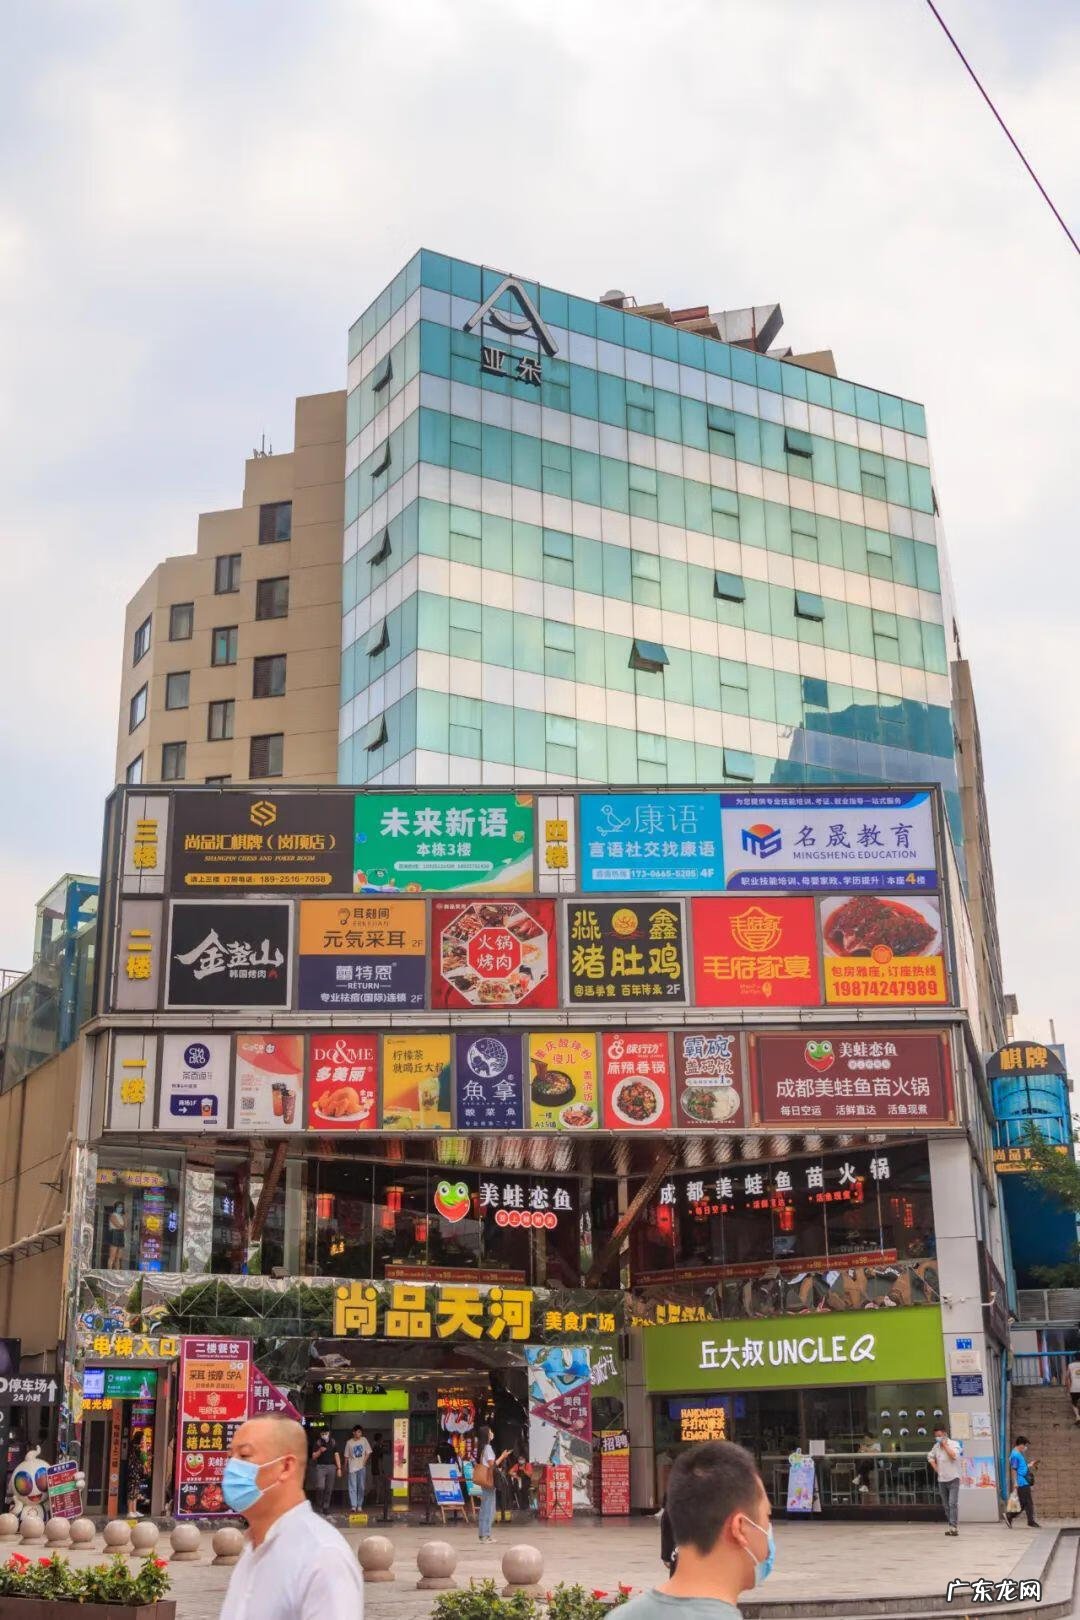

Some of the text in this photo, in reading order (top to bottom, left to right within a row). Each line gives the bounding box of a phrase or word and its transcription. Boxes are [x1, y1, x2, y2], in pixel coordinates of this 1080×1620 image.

[481, 346, 542, 384] 亚朵
[380, 807, 508, 838] 未来新语
[634, 804, 698, 835] 康语
[134, 819, 158, 869] 三楼
[545, 819, 569, 869] 四楼
[794, 823, 914, 849] 名晟教育
[416, 842, 472, 857] 本栋3楼
[588, 840, 715, 858] 言语社交找康语
[793, 850, 917, 859] MINGSHENG EDUCATION
[700, 868, 714, 878] 4F
[412, 940, 423, 948] 2F
[478, 935, 514, 951] 火锅
[126, 929, 152, 980] 二楼
[476, 954, 512, 971] 烤肉
[571, 944, 681, 980] 猪肚鸡
[229, 968, 267, 979] 韩国烤肉
[703, 956, 811, 980] 毛府家宴
[410, 994, 423, 1003] 2F
[621, 984, 663, 996] 百年传承
[666, 984, 681, 995] 2F
[393, 1049, 424, 1060] 柠檬茶
[840, 1042, 898, 1058] 美蛙恋鱼
[1000, 1046, 1048, 1070] 棋牌
[393, 1062, 444, 1073] 就喝丘大叔
[607, 1061, 666, 1075] 麻辣香锅
[120, 1059, 147, 1105] 一楼
[462, 1079, 517, 1101] 魚拿
[776, 1077, 931, 1098] 成都美蛙鱼苗火锅
[780, 1104, 928, 1116] 每日空运 活鲜直达 活鱼现煮
[659, 1157, 891, 1205] 成都美蛙鱼苗火锅
[479, 1183, 573, 1211] 美蛙恋鱼
[332, 1281, 534, 1341] 尚品天河
[544, 1311, 616, 1333] 美食广场
[93, 1335, 177, 1357] 电梯入口
[195, 1342, 240, 1354] 二楼餐饮
[698, 1338, 765, 1370] 丘大叔
[189, 1369, 206, 1380] 采耳
[226, 1371, 242, 1380] SPA
[258, 1399, 275, 1411] 广场
[602, 1434, 628, 1453] 招聘
